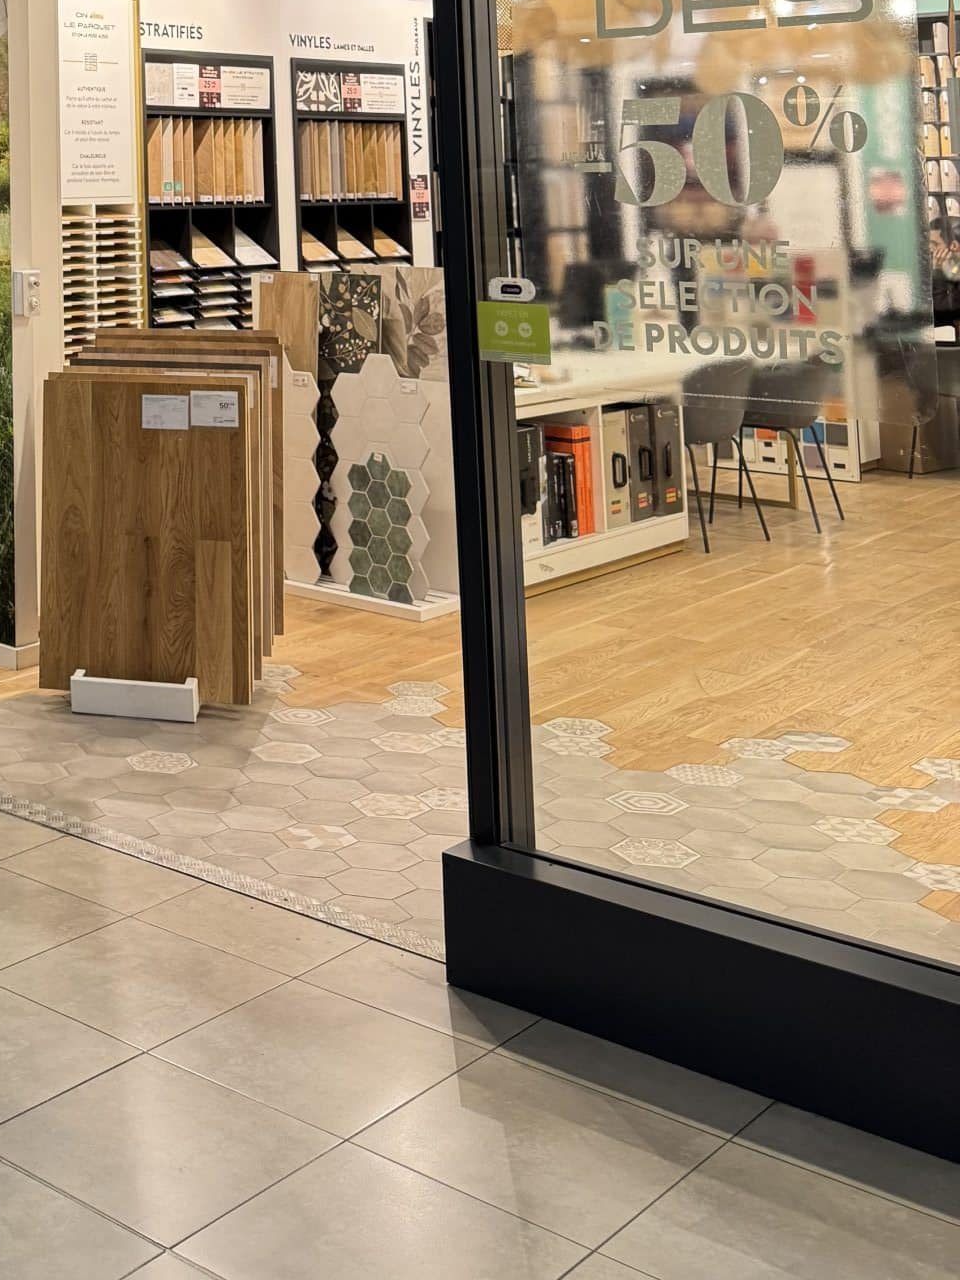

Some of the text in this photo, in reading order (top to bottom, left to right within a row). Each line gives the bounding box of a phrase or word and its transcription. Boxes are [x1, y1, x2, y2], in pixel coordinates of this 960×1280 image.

[140, 22, 203, 40] STRATIFIÉS
[289, 33, 332, 50] VINYLES
[408, 60, 423, 156] VINYLES
[635, 236, 791, 271] SUR UNE
[593, 320, 636, 352] DE
